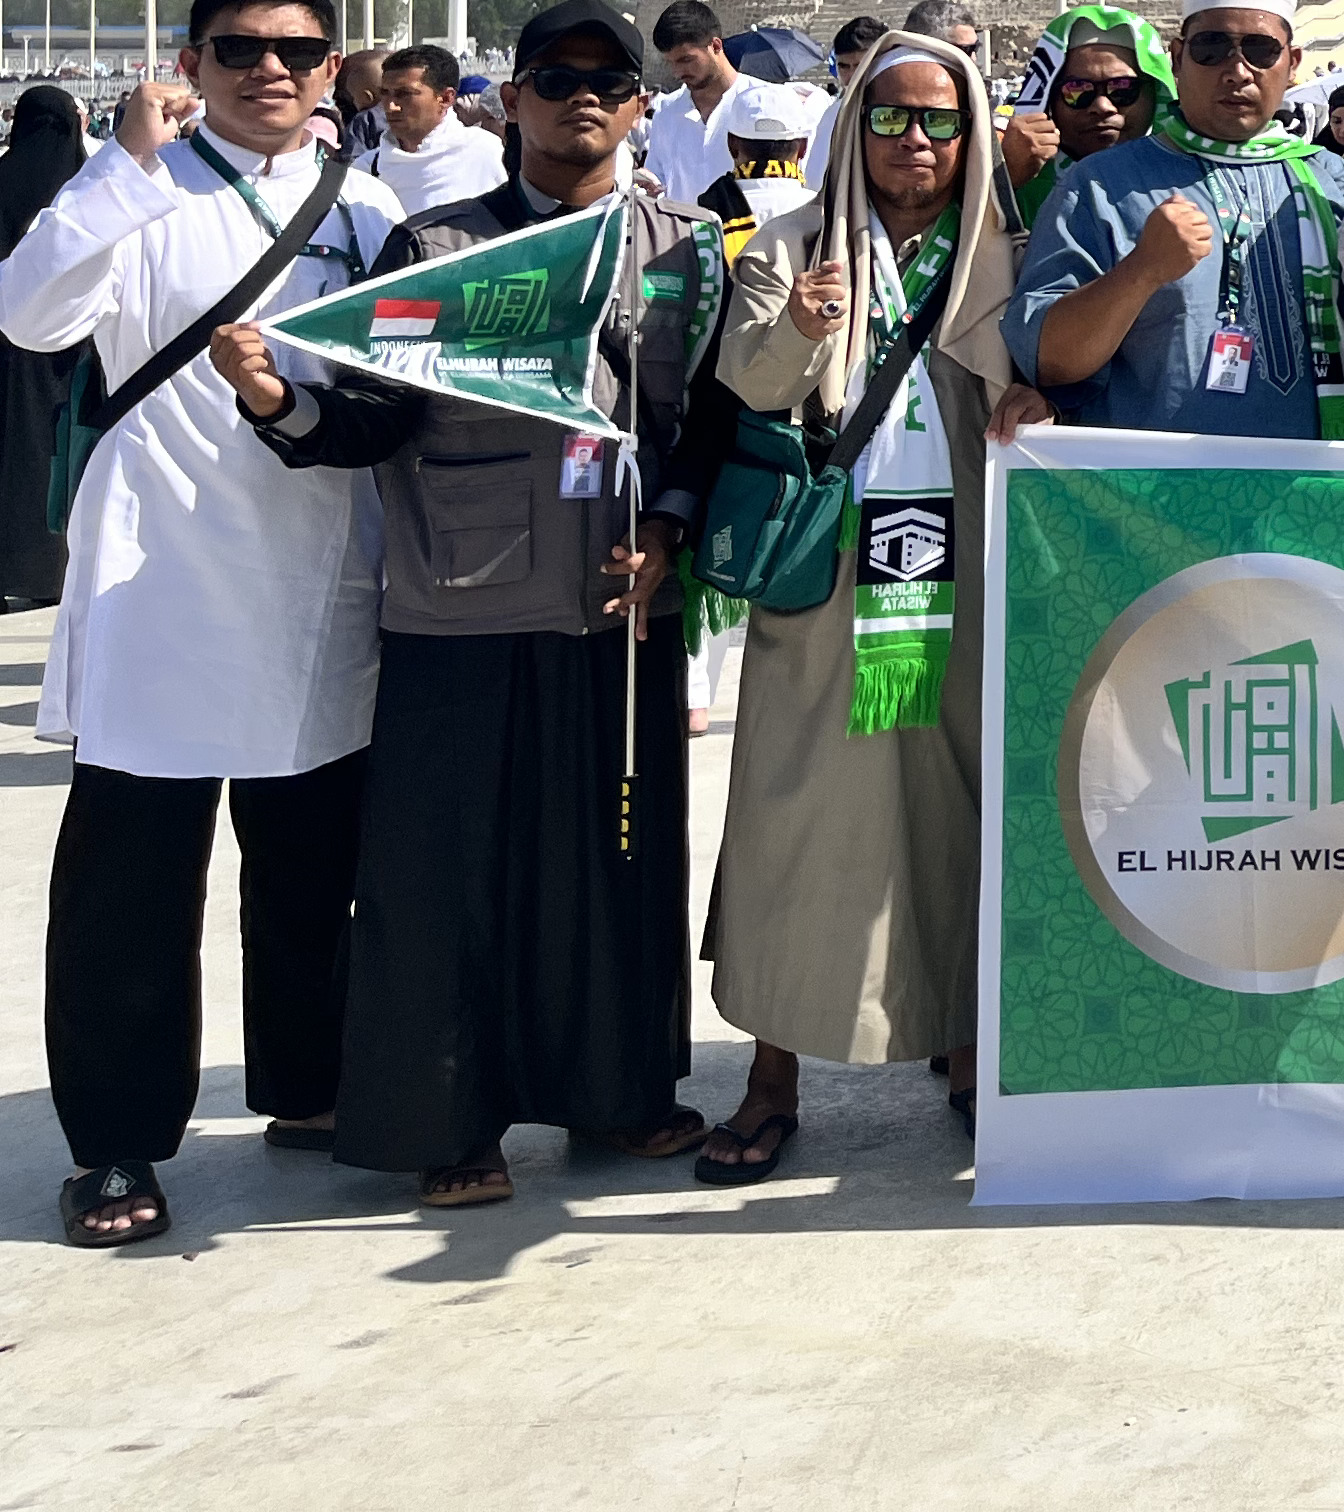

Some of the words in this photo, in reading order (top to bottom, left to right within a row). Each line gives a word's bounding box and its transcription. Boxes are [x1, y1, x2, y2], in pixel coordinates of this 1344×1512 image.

[502, 357, 553, 371] WISATA
[1117, 849, 1157, 873] EL
[1166, 849, 1281, 871] HIJRAH
